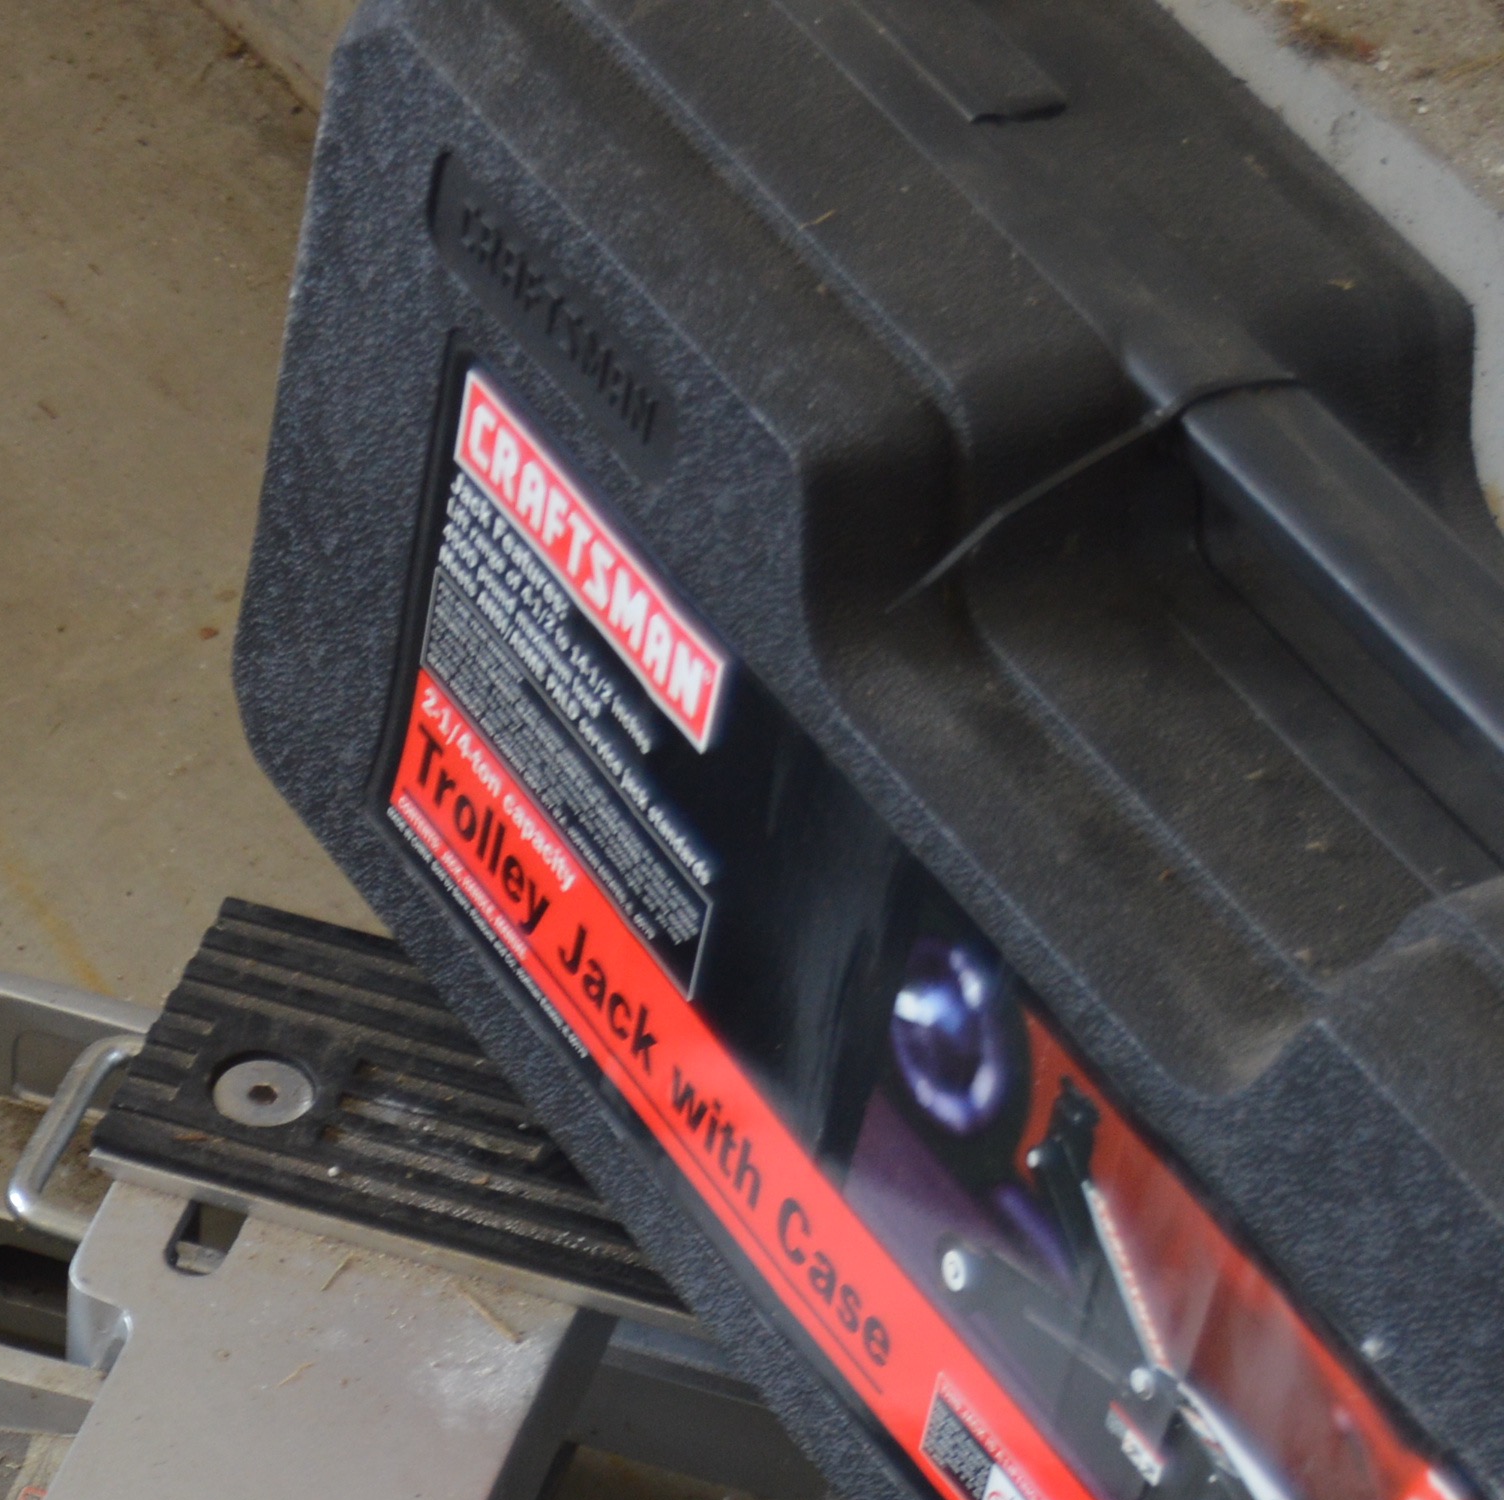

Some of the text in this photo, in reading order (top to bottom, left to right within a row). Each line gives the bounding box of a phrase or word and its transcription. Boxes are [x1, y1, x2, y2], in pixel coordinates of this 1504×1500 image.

[450, 472, 493, 528] Jack
[467, 403, 705, 719] CRAFTSMAN
[469, 527, 507, 575] range
[506, 569, 523, 590] of
[421, 687, 577, 892] 2-1/4-ton capacity
[647, 804, 712, 886] standards
[416, 721, 551, 936] Trolley
[557, 923, 659, 1076] Jack
[669, 1064, 764, 1211] with
[774, 1196, 892, 1368] Case
